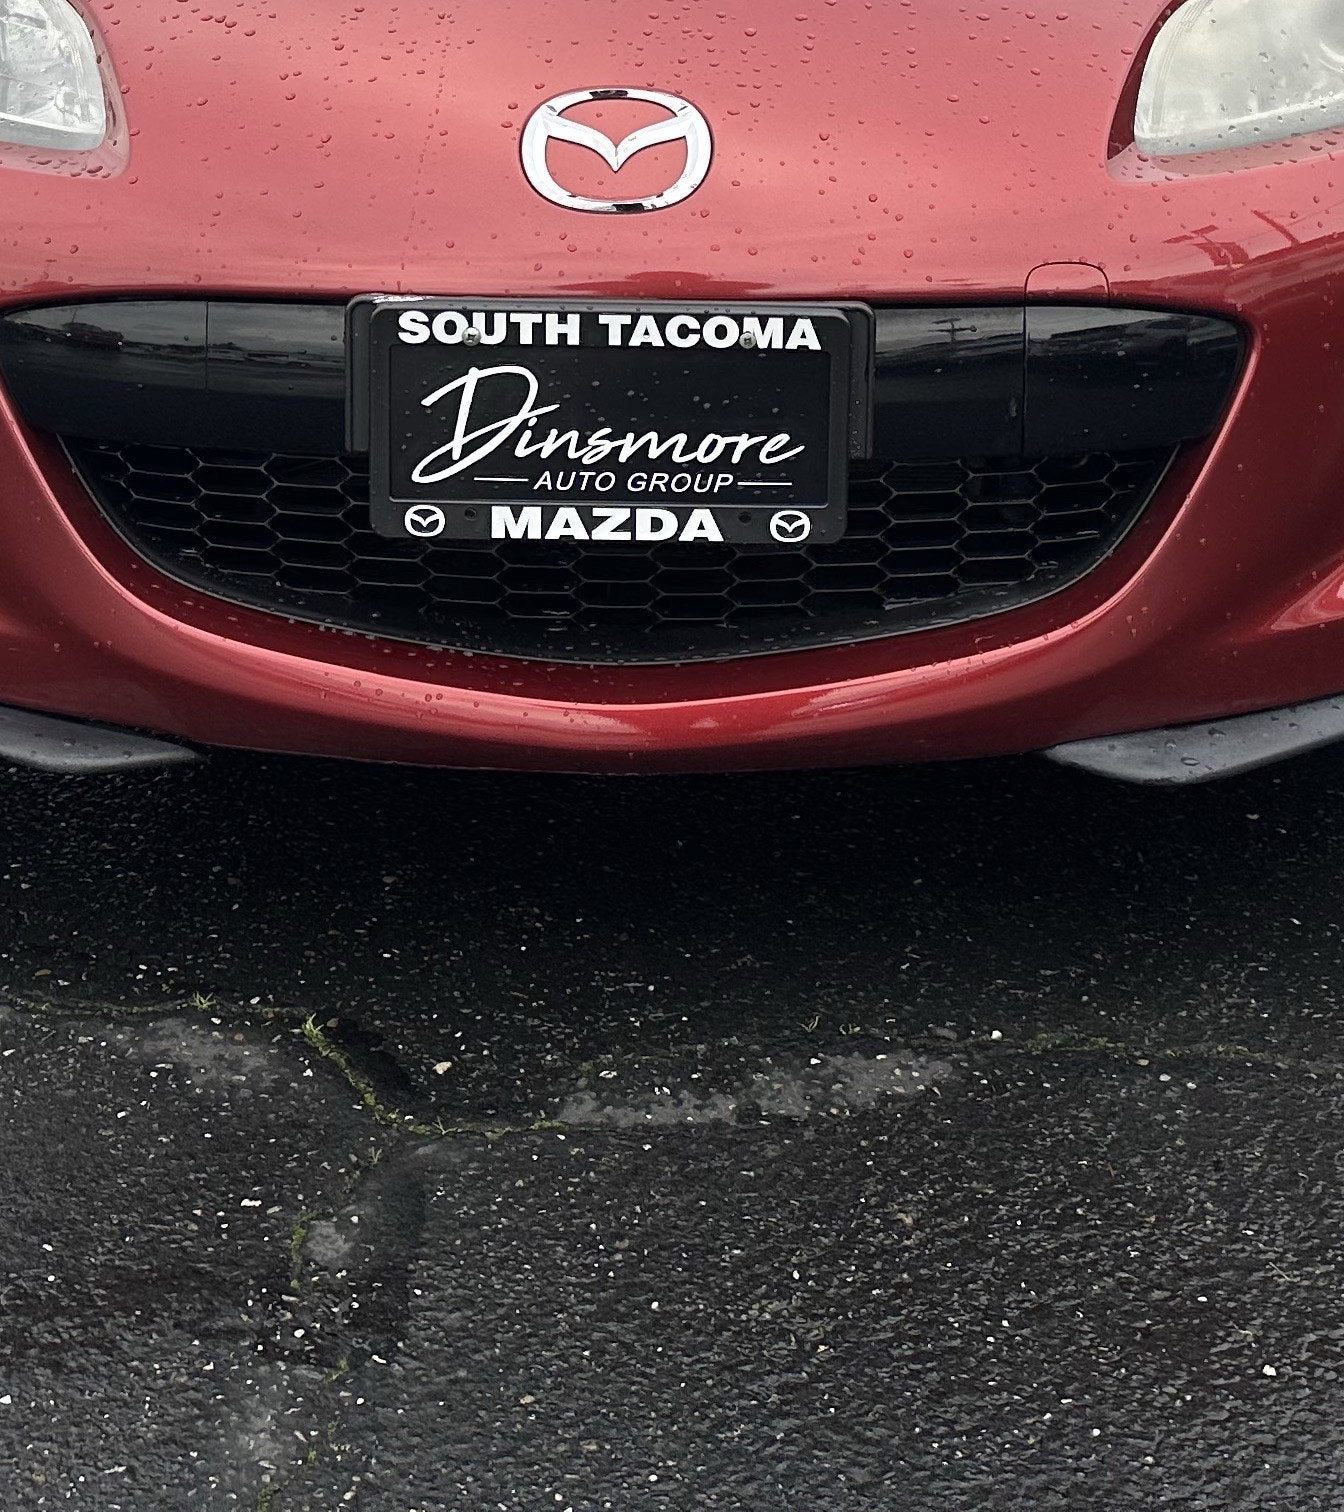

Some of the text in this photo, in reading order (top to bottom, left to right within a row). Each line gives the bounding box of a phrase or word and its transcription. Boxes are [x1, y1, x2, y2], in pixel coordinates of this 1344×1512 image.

[397, 310, 822, 351] SOUTH TACOMA
[410, 365, 805, 485] Dinsmore
[533, 471, 734, 494] AUTO GROUP
[490, 506, 724, 543] MAZDA
